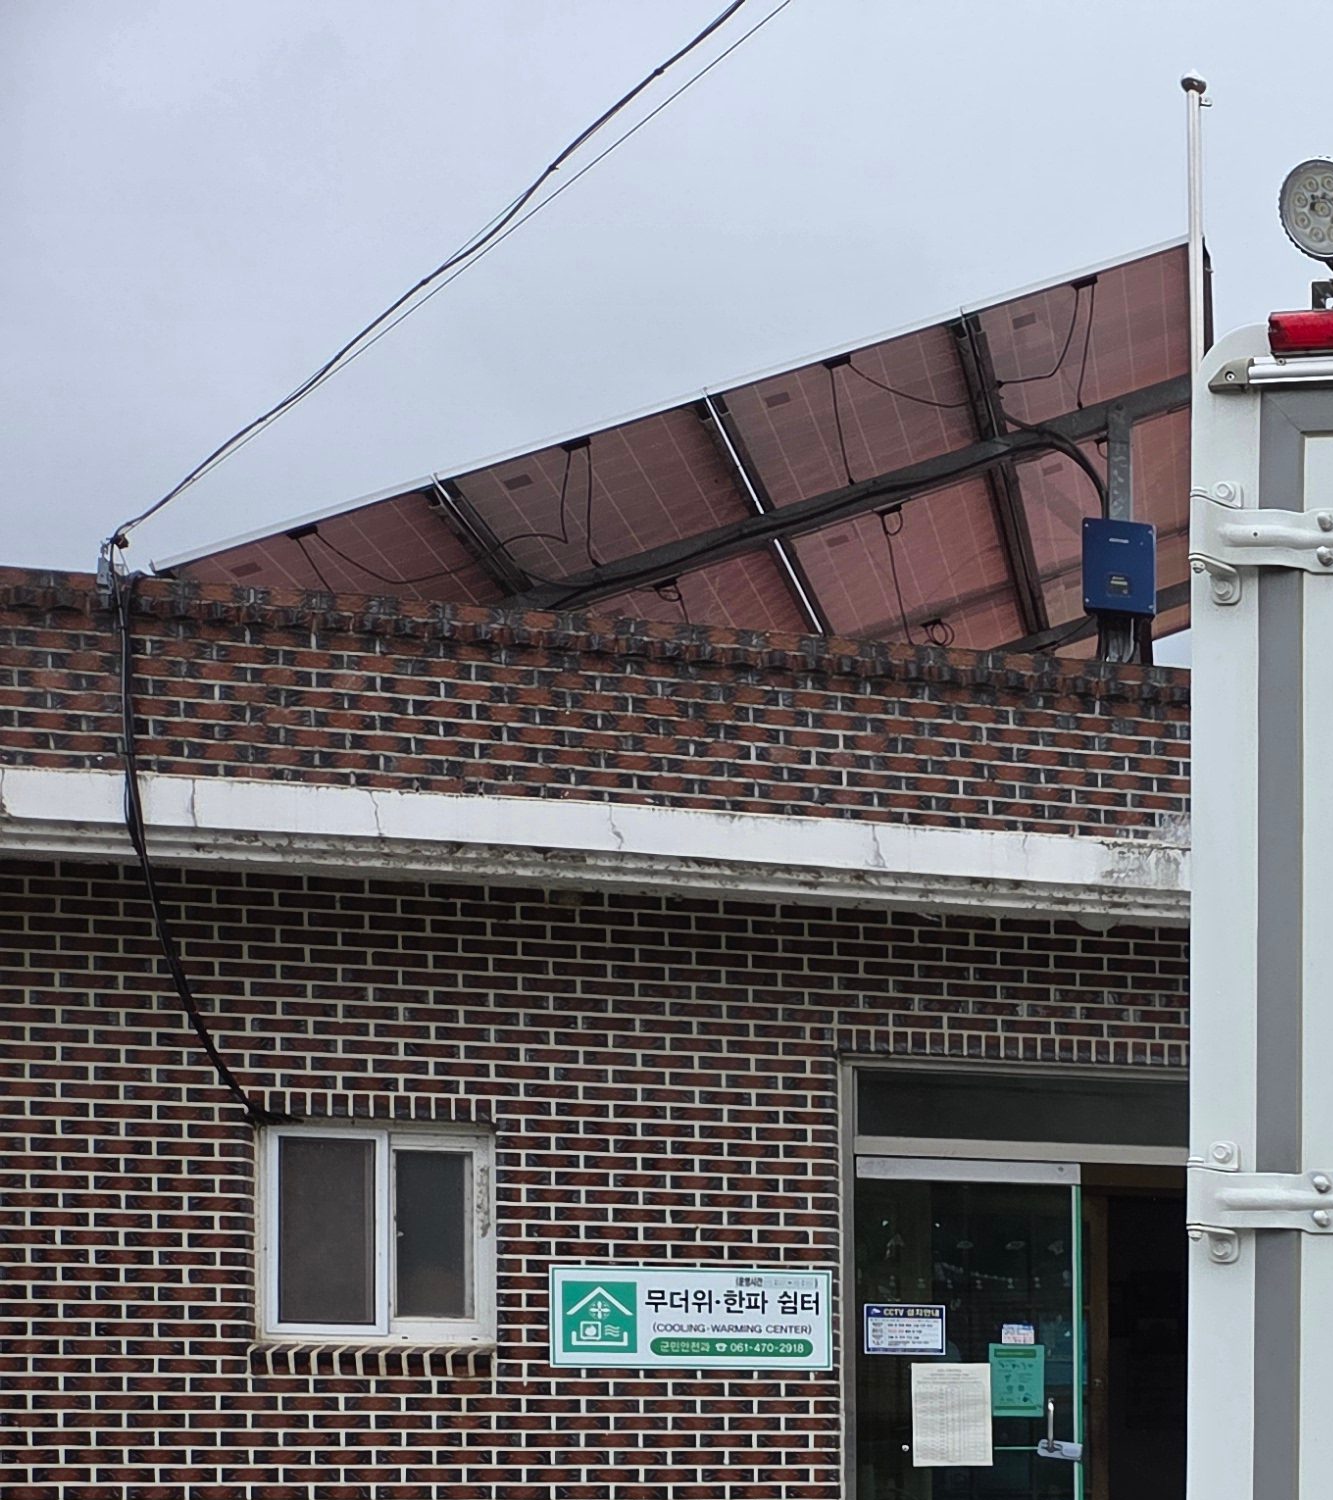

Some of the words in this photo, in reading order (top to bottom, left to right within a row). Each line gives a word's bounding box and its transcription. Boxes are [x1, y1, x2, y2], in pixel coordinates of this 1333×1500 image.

[777, 1290, 820, 1316] 쉼터
[883, 1308, 904, 1317] CCTV
[765, 1324, 812, 1335] CENTER)
[729, 1342, 805, 1354] 061-470-2918
